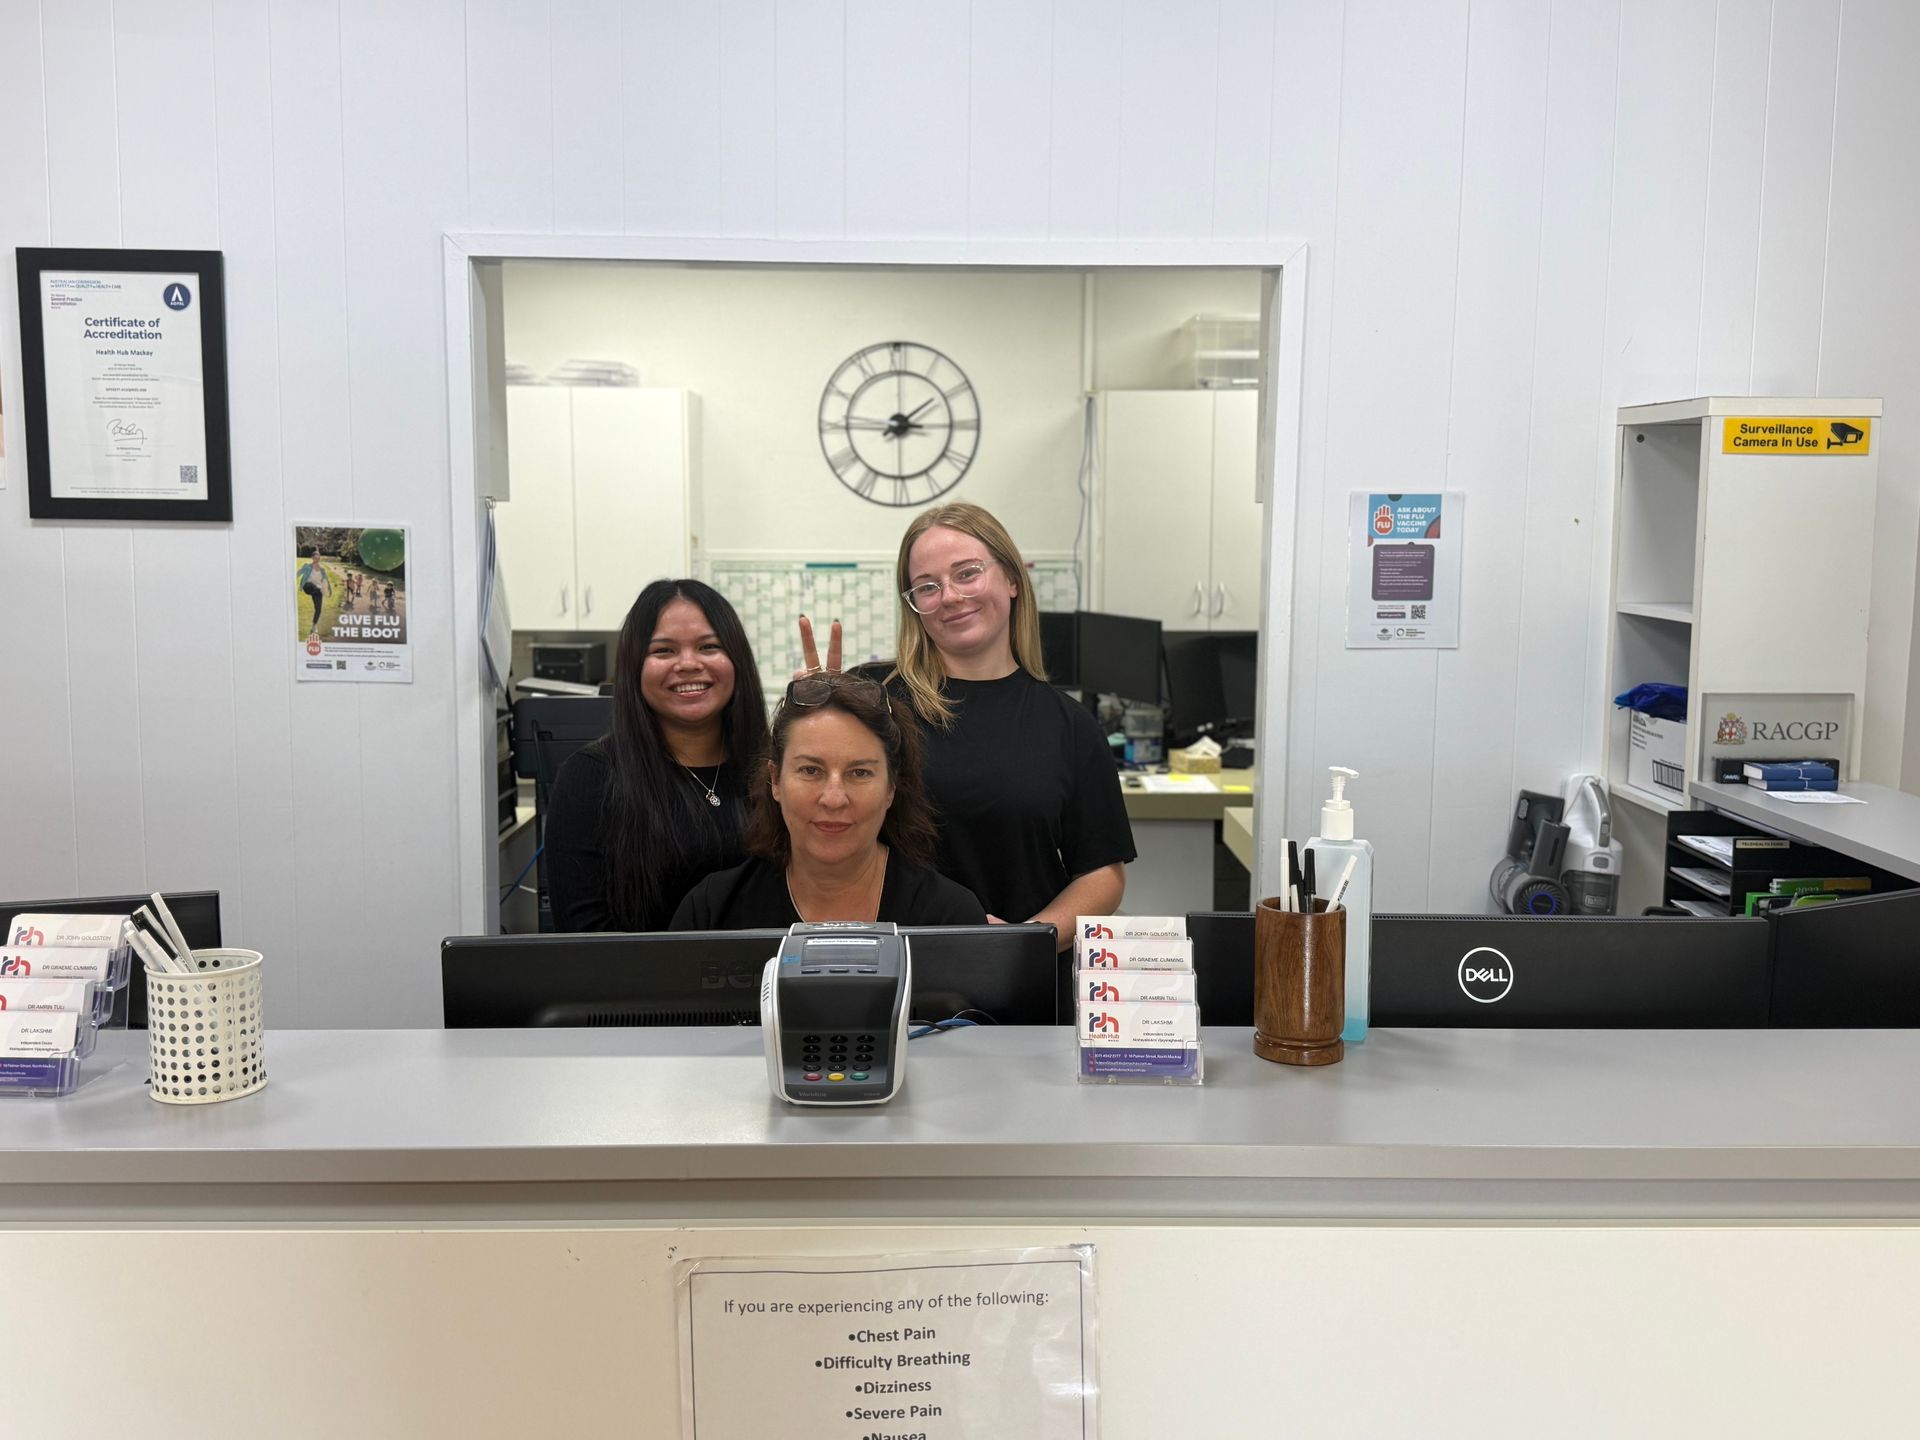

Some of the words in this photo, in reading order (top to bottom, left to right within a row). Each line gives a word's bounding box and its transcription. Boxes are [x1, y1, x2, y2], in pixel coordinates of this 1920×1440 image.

[84, 316, 146, 328] Certificate
[148, 318, 160, 328] of
[84, 329, 162, 340] Accreditation
[130, 350, 153, 358] Mackay
[1740, 424, 1813, 434] Surveillance
[1733, 436, 1778, 448] Camera
[1782, 437, 1792, 447] In
[1796, 437, 1818, 448] Use
[1376, 521, 1391, 529] FLU
[339, 615, 371, 625] GIVE
[374, 616, 400, 626] FLU
[332, 626, 360, 638] THE
[362, 627, 400, 638] BOOT
[1752, 722, 1839, 741] RACGP
[1465, 968, 1508, 982] DELL
[724, 1300, 734, 1312] If
[738, 1302, 765, 1316] you
[770, 1302, 793, 1313] are
[798, 1299, 893, 1316] experiencing
[897, 1298, 923, 1312] any
[927, 1294, 944, 1308] of
[947, 1294, 972, 1307] the
[975, 1290, 1048, 1306] following:
[856, 1329, 899, 1343] Chest
[903, 1326, 936, 1340] Pain
[824, 1356, 892, 1371] Difficulty
[897, 1352, 971, 1367] Breathing
[864, 1380, 932, 1394] Dizziness
[854, 1407, 905, 1420] Severe
[910, 1404, 942, 1418] Pain
